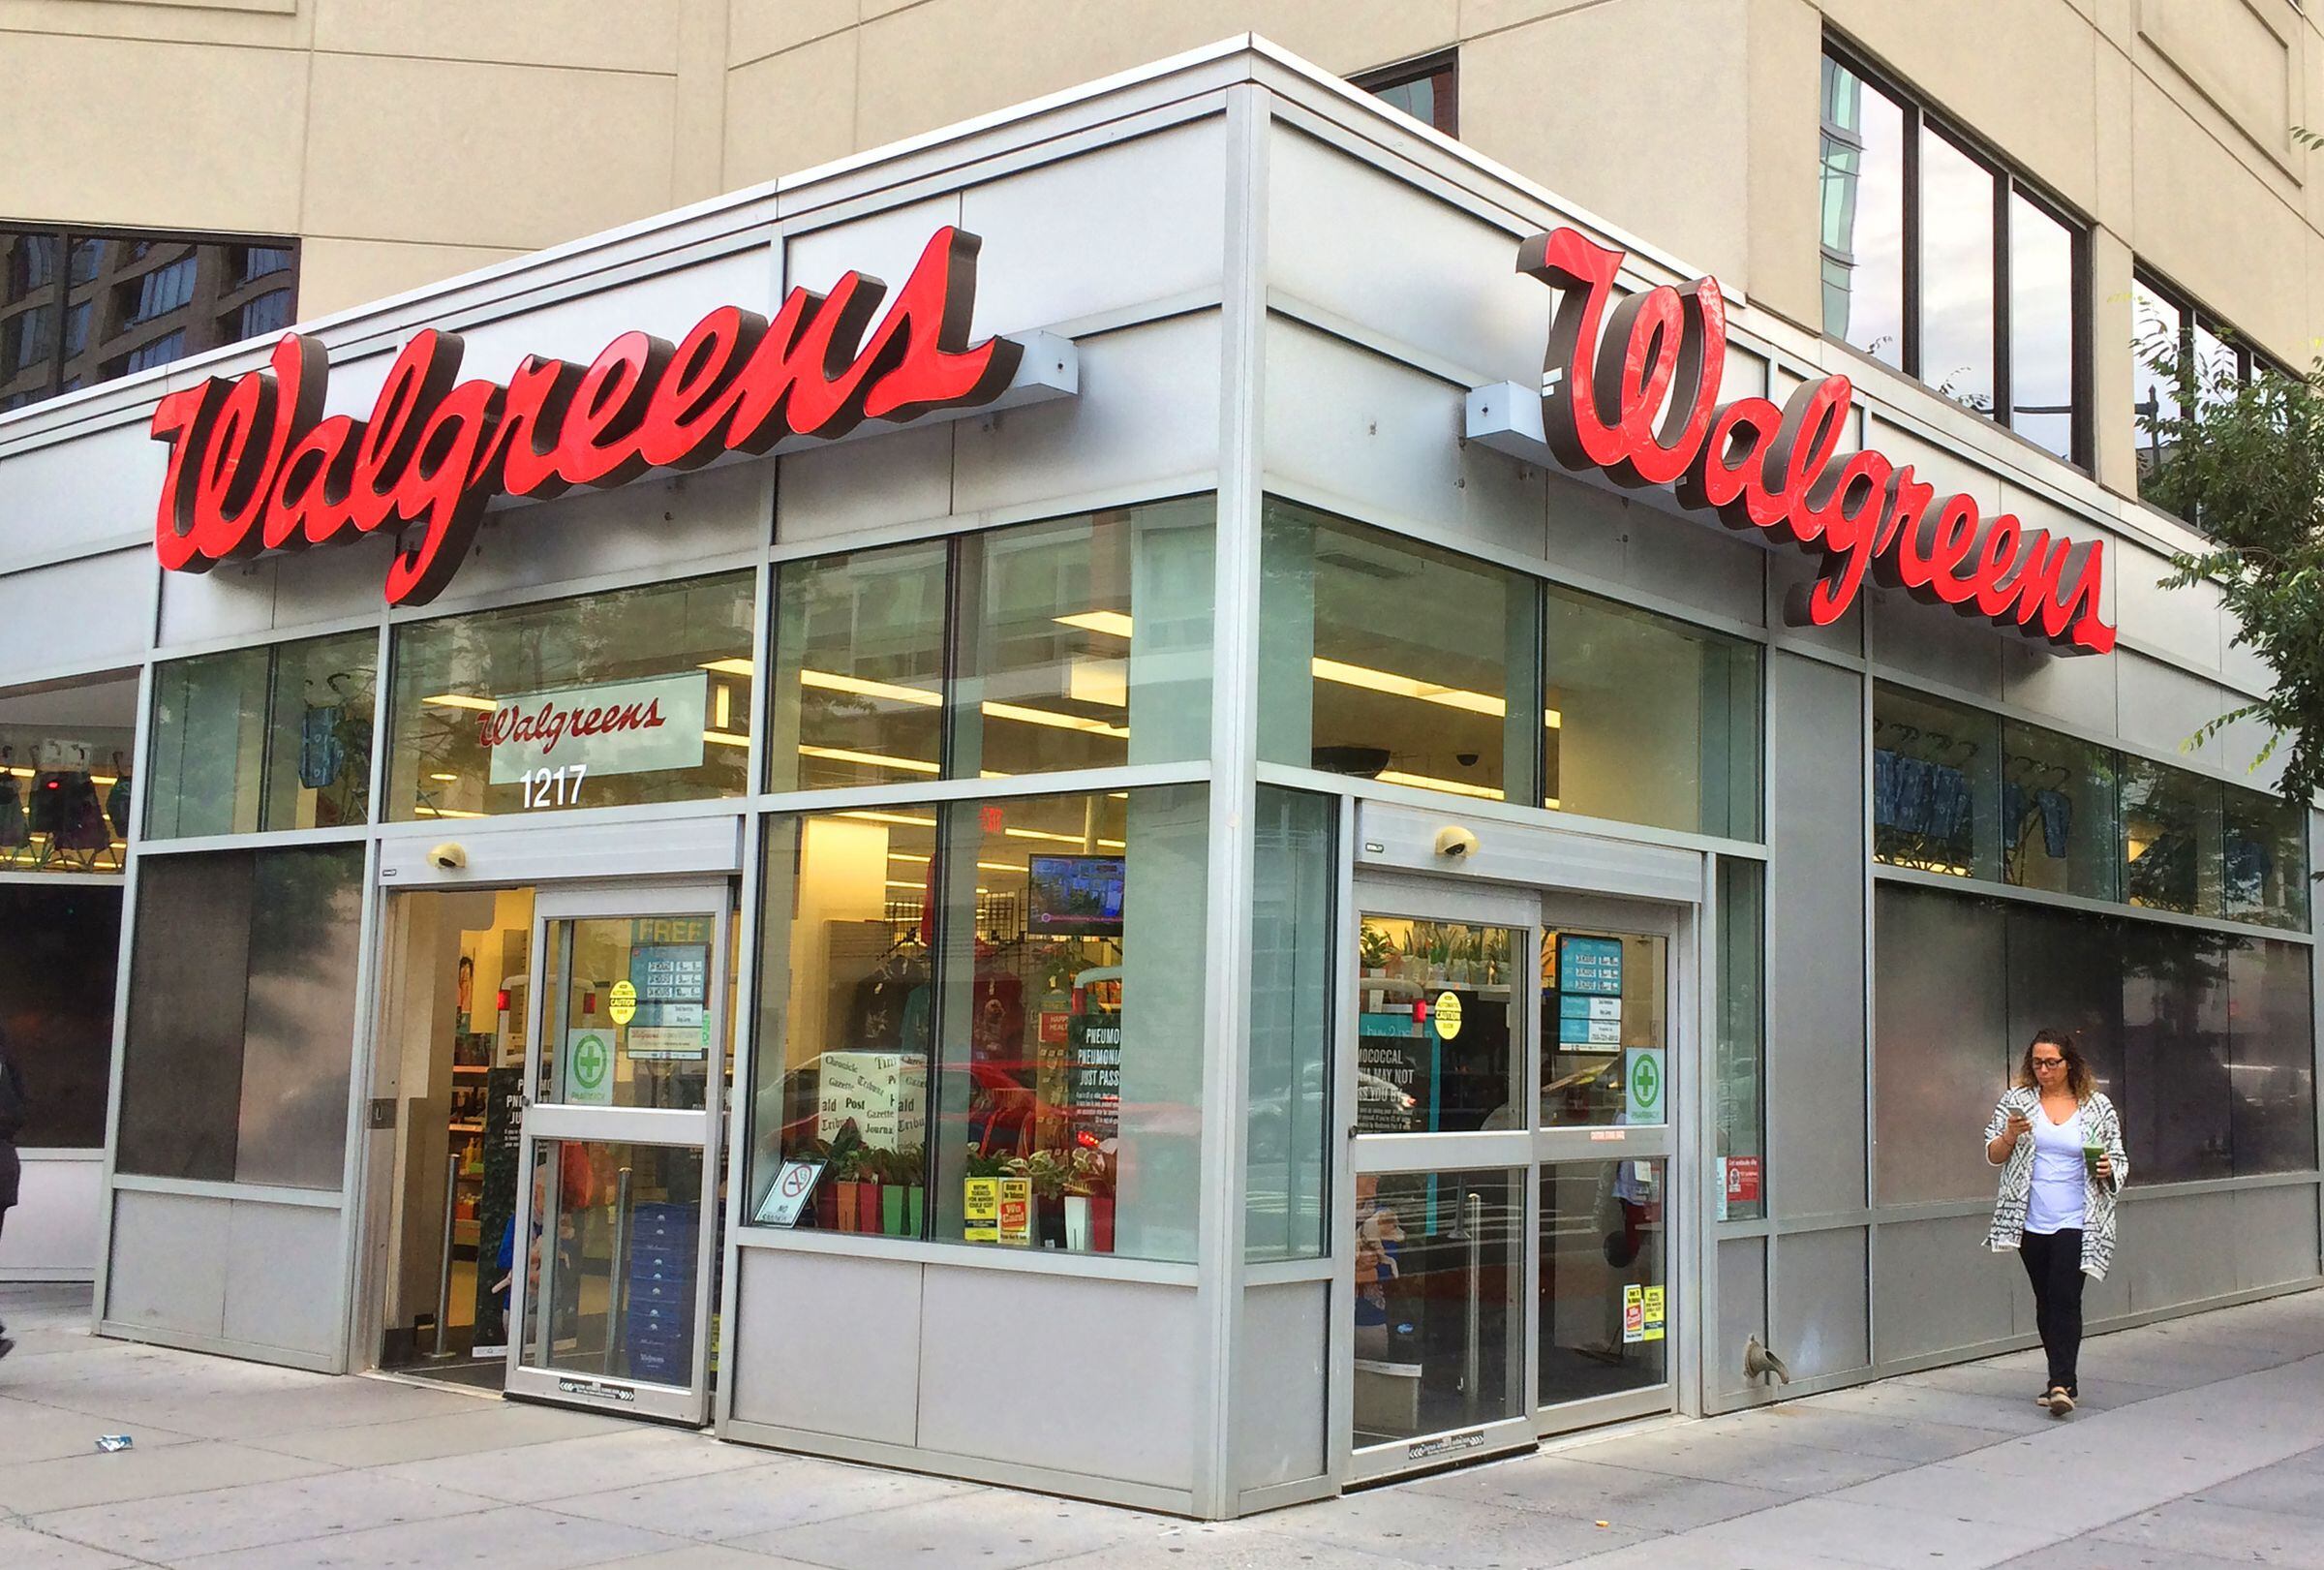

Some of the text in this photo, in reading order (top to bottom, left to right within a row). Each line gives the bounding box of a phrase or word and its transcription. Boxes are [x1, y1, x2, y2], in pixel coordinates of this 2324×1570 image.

[151, 225, 1024, 606] Walgreens
[1517, 227, 2117, 657] Walgreens
[475, 697, 667, 754] Walgreens
[520, 763, 588, 809] 1217
[829, 1077, 854, 1092] Gazette
[1080, 1069, 1120, 1086] JUST PASS
[1394, 1068, 1415, 1085] NOT
[845, 1096, 866, 1110] Post
[898, 1098, 915, 1112] ald
[867, 1109, 894, 1119] Gazette
